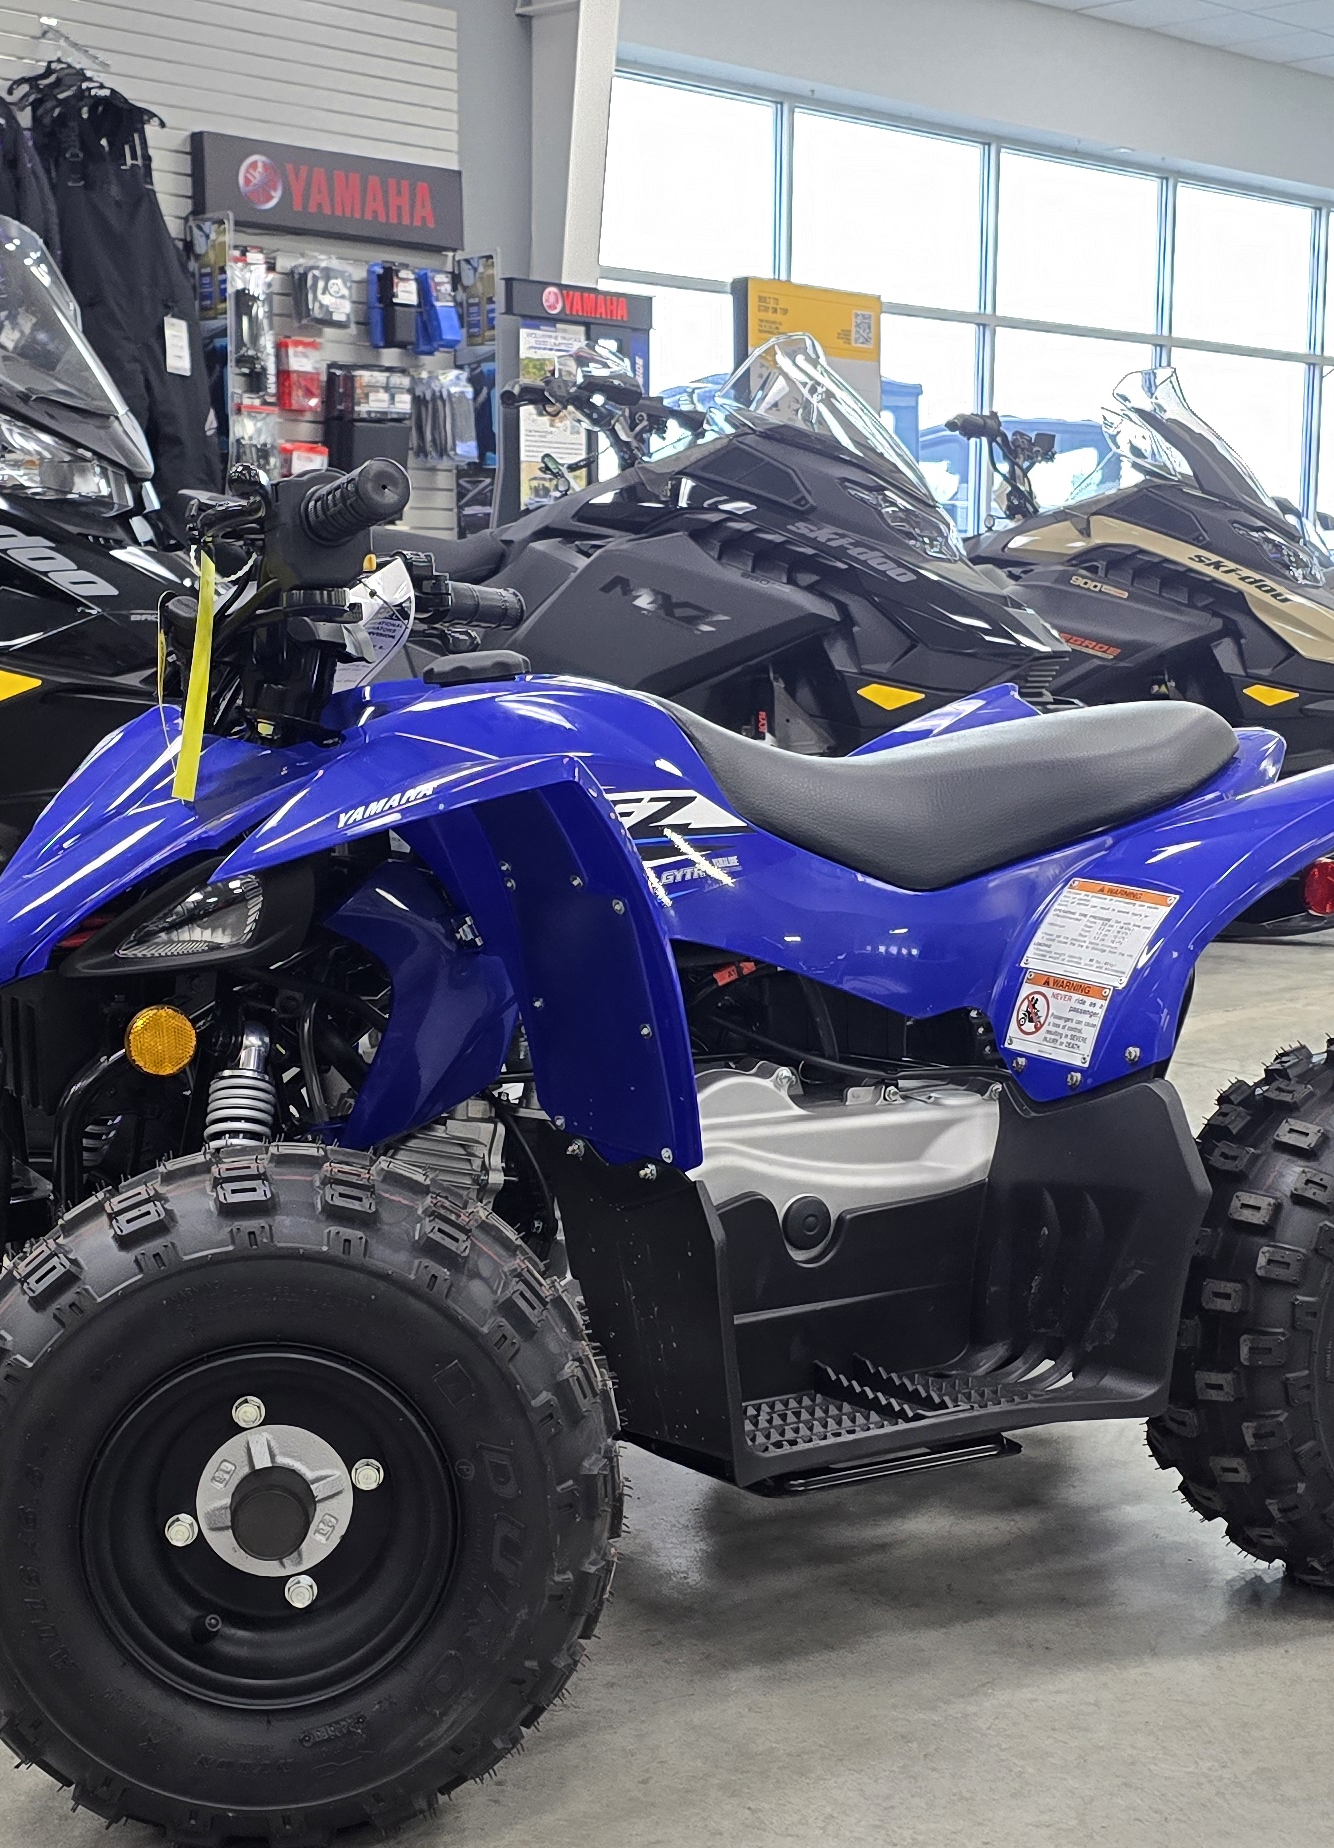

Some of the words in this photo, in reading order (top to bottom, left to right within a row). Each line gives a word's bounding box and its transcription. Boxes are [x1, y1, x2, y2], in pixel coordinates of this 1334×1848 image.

[285, 163, 436, 229] YAMAHA
[562, 289, 628, 321] YAMAHA
[786, 521, 918, 583] ski-doo
[1070, 575, 1102, 593] 900
[1187, 553, 1294, 604] ski-doo
[337, 783, 435, 829] YAMAHA
[1107, 887, 1143, 900] WARNING
[1051, 991, 1073, 1002] NEVER
[1074, 997, 1086, 1006] ride
[1052, 977, 1092, 995] WARNING
[1069, 1033, 1088, 1044] SEVERE
